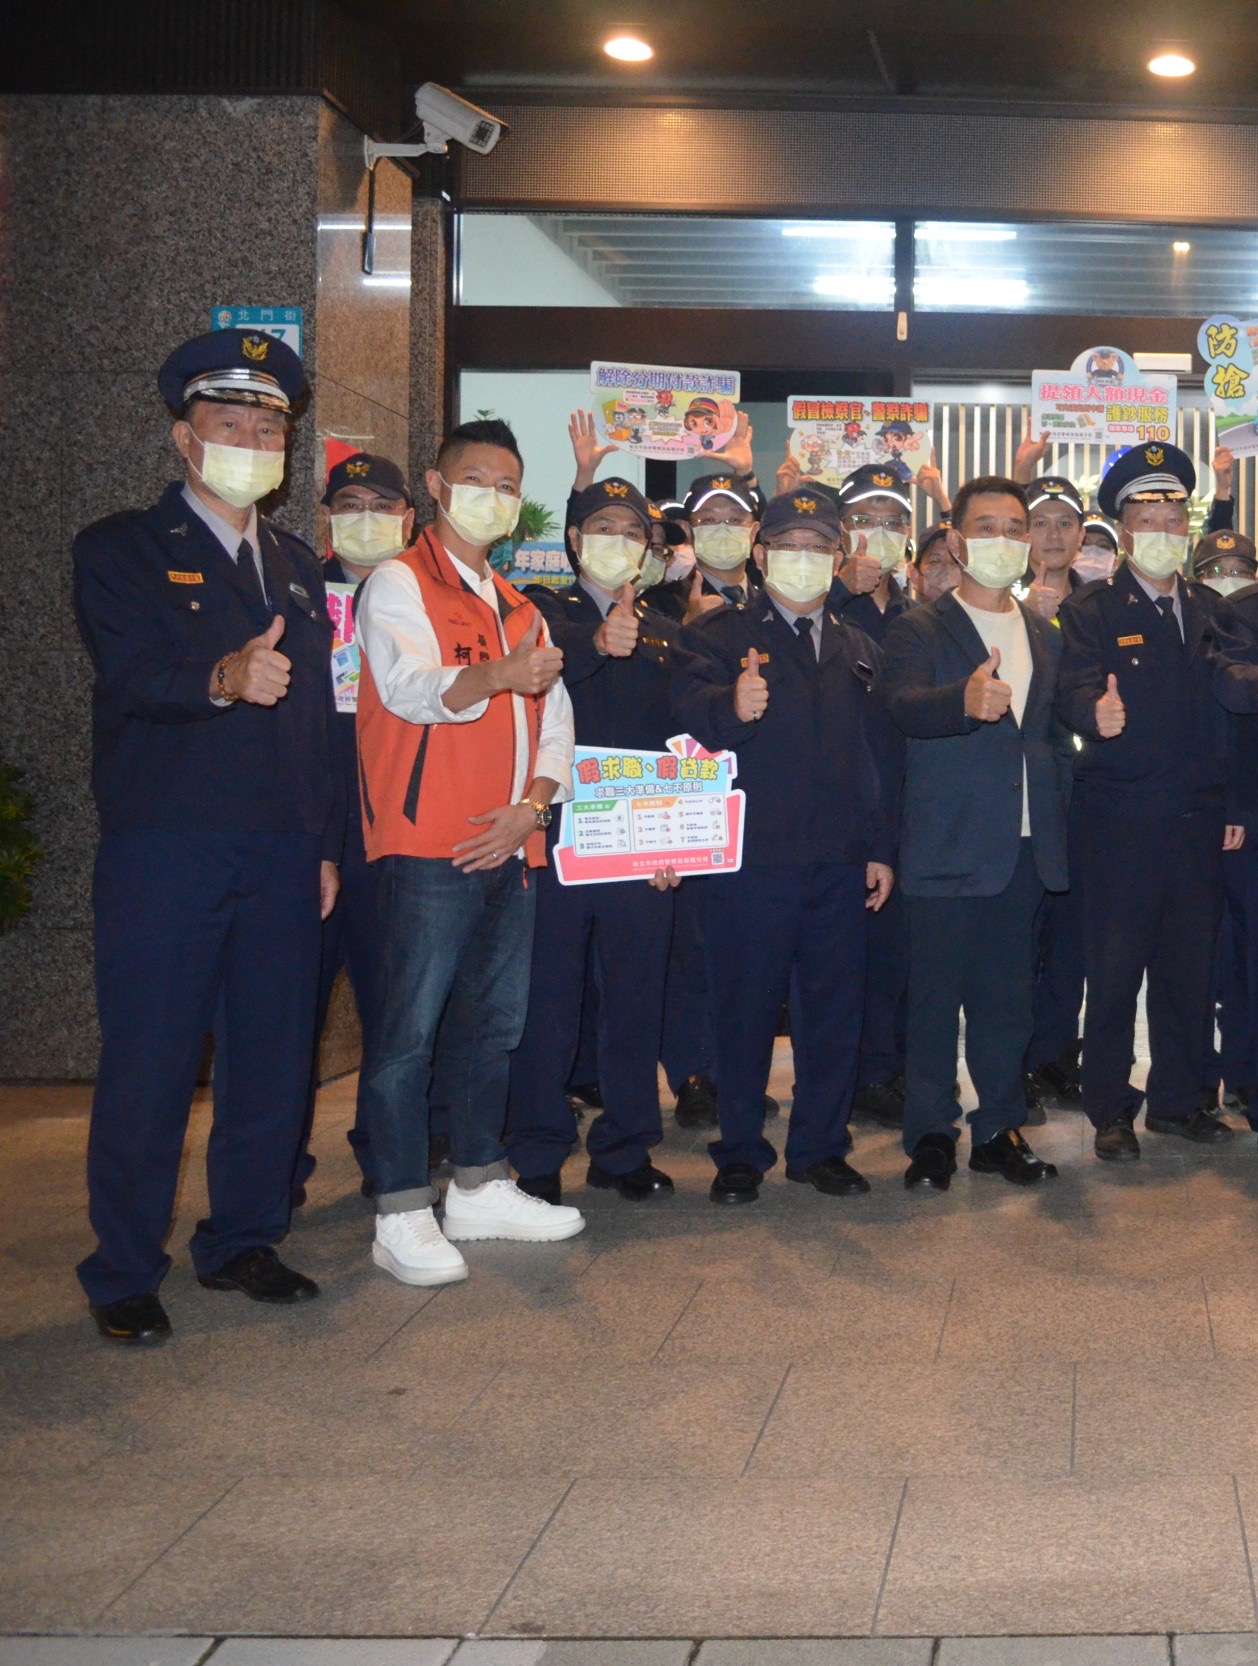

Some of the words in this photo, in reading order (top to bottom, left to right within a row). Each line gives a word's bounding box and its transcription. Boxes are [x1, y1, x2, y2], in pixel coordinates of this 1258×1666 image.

[238, 309, 297, 321] 北門街
[1205, 322, 1250, 399] 防搶
[596, 366, 736, 395] 解除分期付款詐騙
[1040, 384, 1168, 403] 提領大額現金
[792, 400, 929, 422] 假冒檢察官、警察詐騙
[1106, 404, 1169, 423] 護鈔服務
[1137, 426, 1170, 441] 110
[576, 755, 719, 784] 假求職、假貸款
[595, 781, 703, 798] 求職三大準備&七不原則
